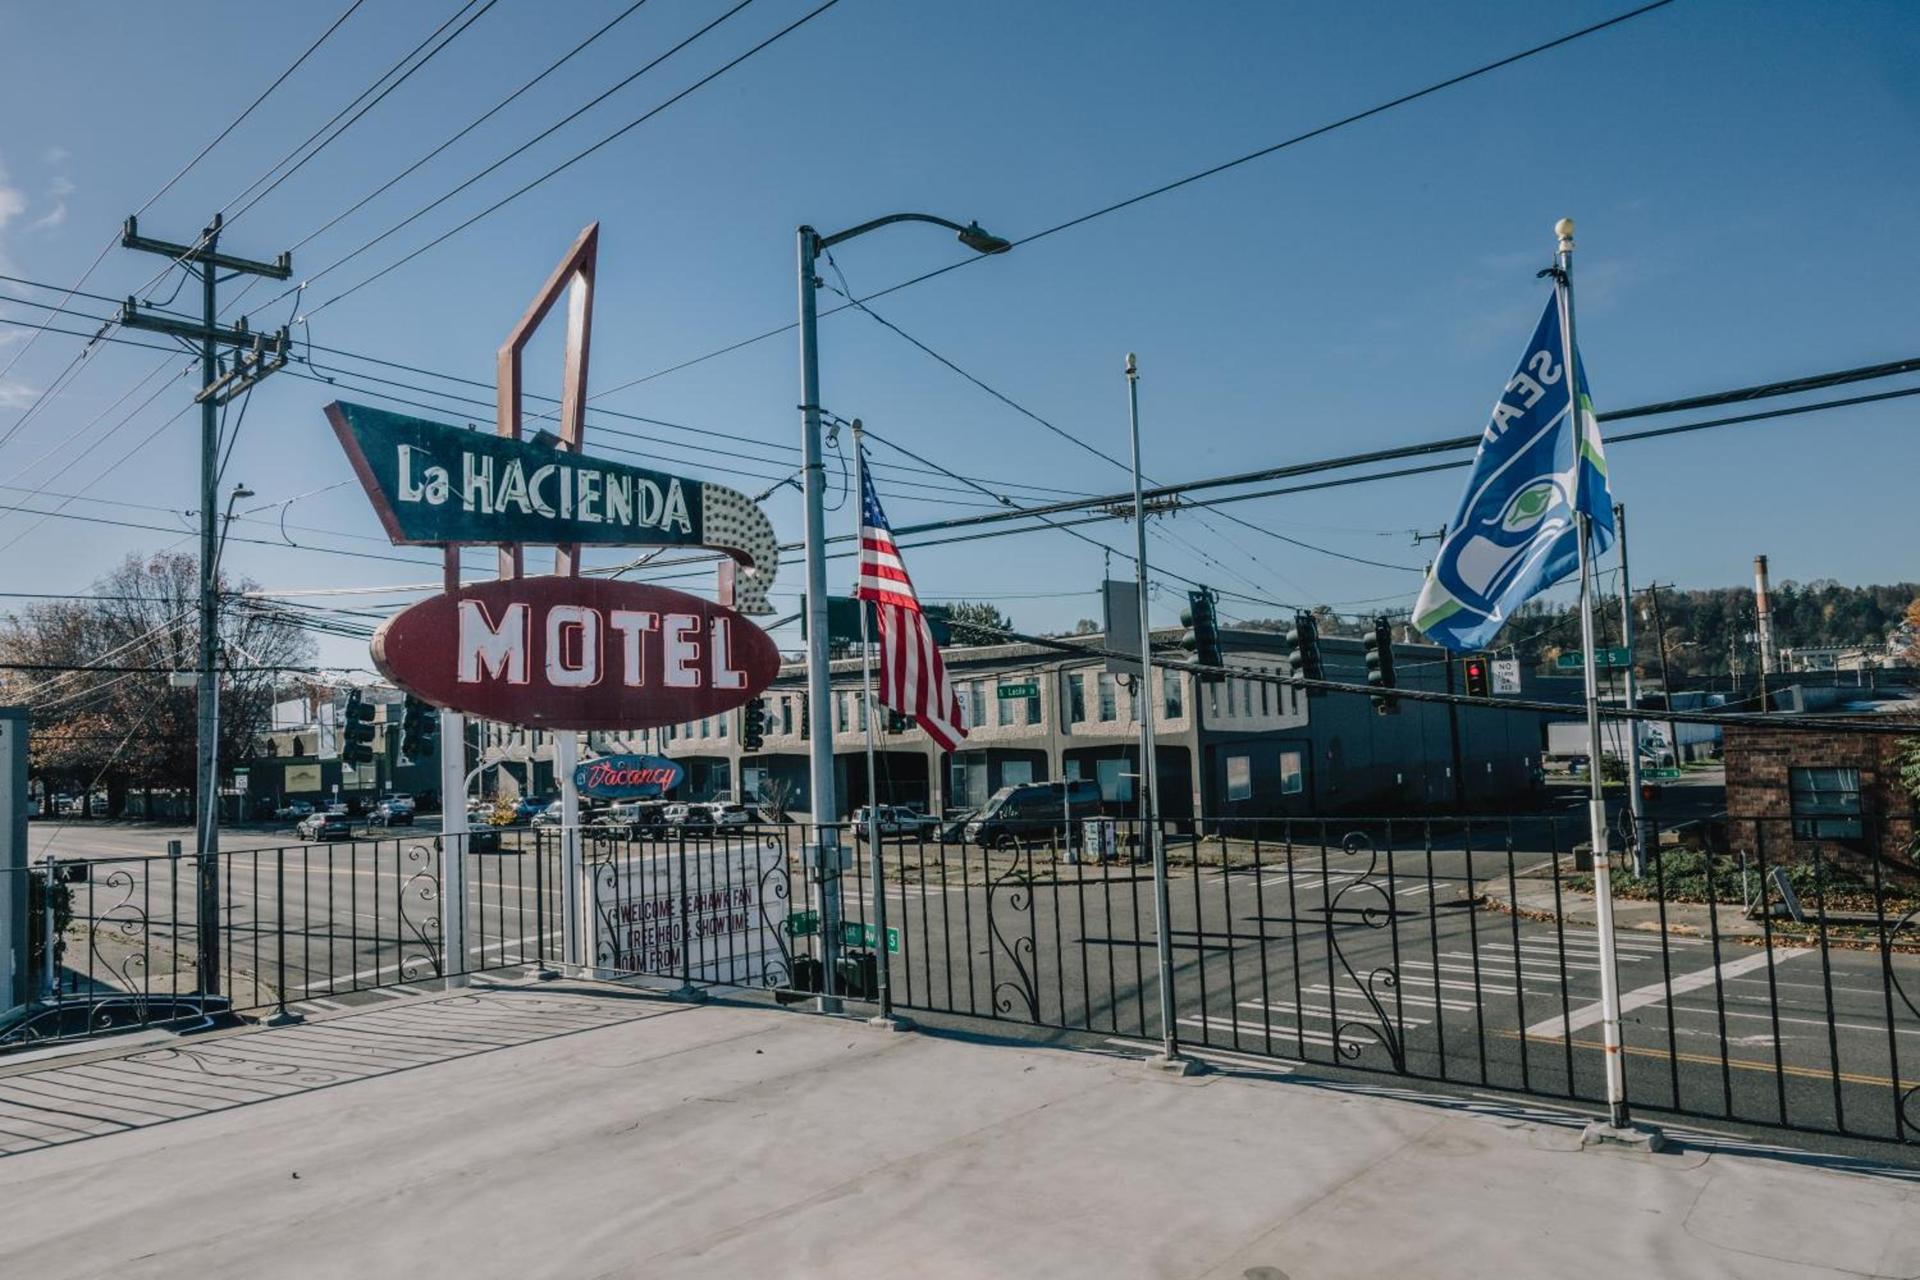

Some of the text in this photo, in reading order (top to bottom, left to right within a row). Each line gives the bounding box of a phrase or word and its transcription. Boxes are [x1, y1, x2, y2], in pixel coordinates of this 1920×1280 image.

[397, 444, 692, 534] La HACIENDA
[457, 599, 748, 690] MOTEL
[1498, 662, 1512, 670] NO
[588, 760, 676, 792] Vacancy
[620, 887, 752, 923] WELCOME EAHAWK FAN
[890, 933, 896, 946] S
[650, 948, 680, 970] FROM
